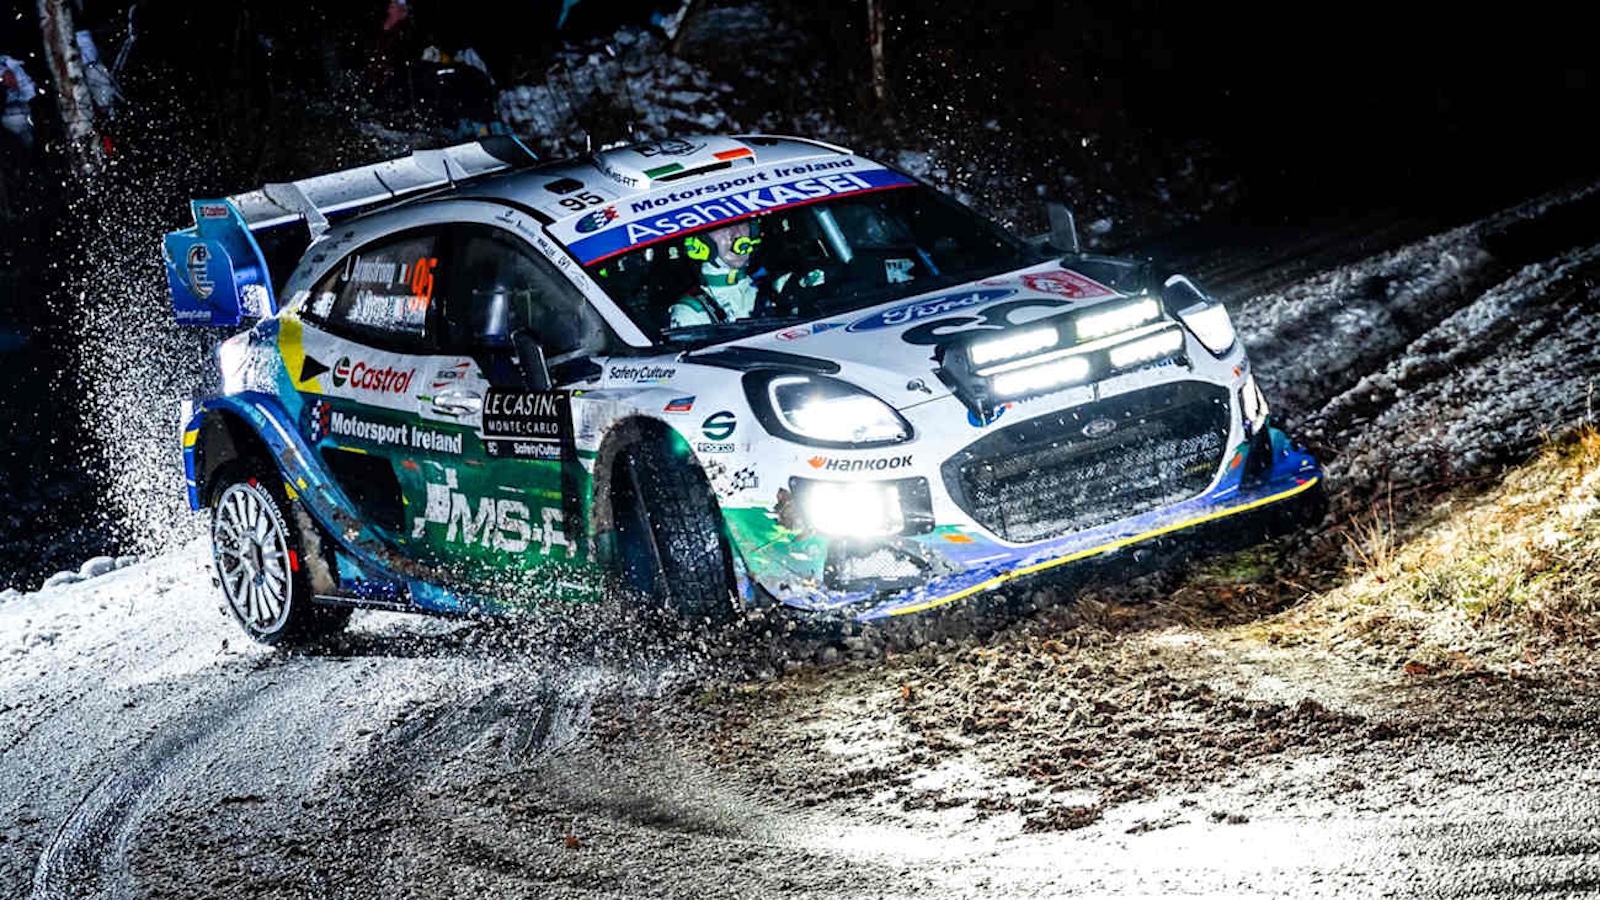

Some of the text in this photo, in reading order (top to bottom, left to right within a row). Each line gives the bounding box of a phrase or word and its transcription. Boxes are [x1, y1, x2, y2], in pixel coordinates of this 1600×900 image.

[559, 191, 605, 212] 95
[631, 157, 855, 214] Motorsport Ireland
[626, 173, 873, 245] AsahiKASEI
[882, 294, 988, 325] Ford
[349, 361, 416, 394] Castrol
[609, 366, 676, 380] SafetyCulture
[484, 393, 502, 415] LE
[331, 411, 408, 444] Motorsport
[411, 426, 463, 454] Ireland
[513, 442, 561, 458] SafetyCultur
[447, 491, 578, 558] MS-R
